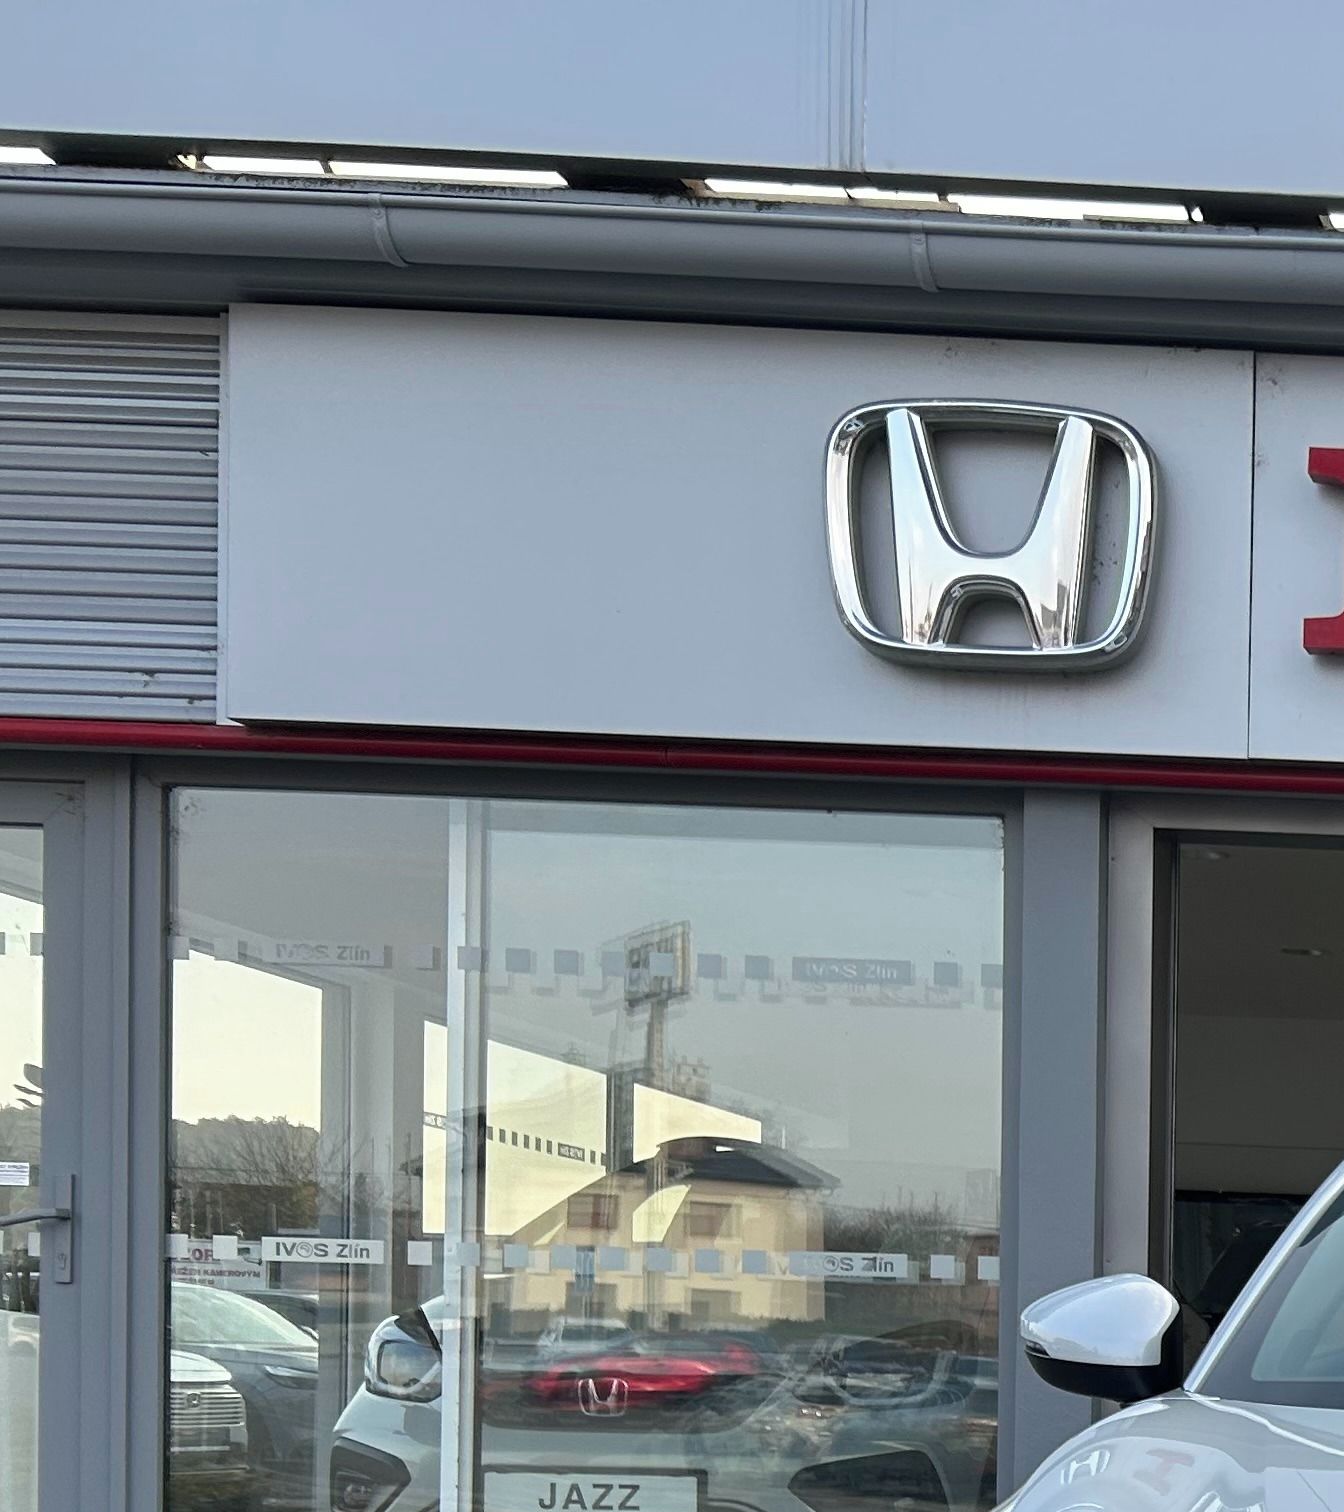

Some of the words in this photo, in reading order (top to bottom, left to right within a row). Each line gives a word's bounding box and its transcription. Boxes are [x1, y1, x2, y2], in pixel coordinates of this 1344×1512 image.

[275, 1241, 329, 1258] IVOS
[336, 1243, 370, 1259] Zlín
[538, 1482, 641, 1511] JAZZ
